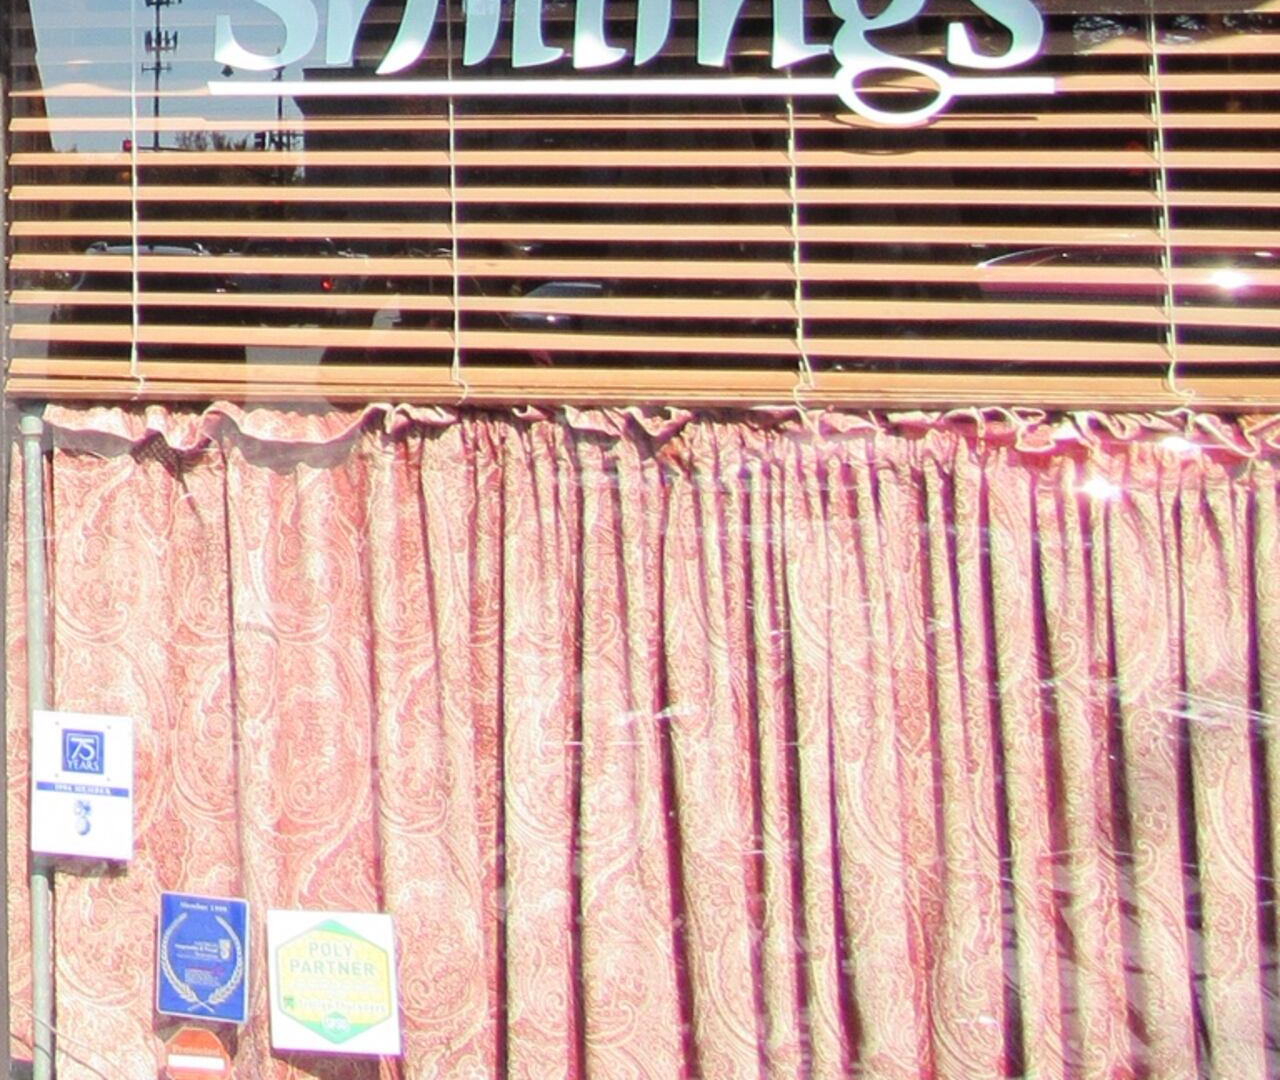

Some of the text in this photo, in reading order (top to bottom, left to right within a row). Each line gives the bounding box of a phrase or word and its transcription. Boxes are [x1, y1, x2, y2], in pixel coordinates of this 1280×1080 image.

[70, 736, 96, 761] 75
[67, 759, 100, 772] YEARS
[308, 942, 353, 958] POLY
[289, 959, 376, 977] PARTNER
